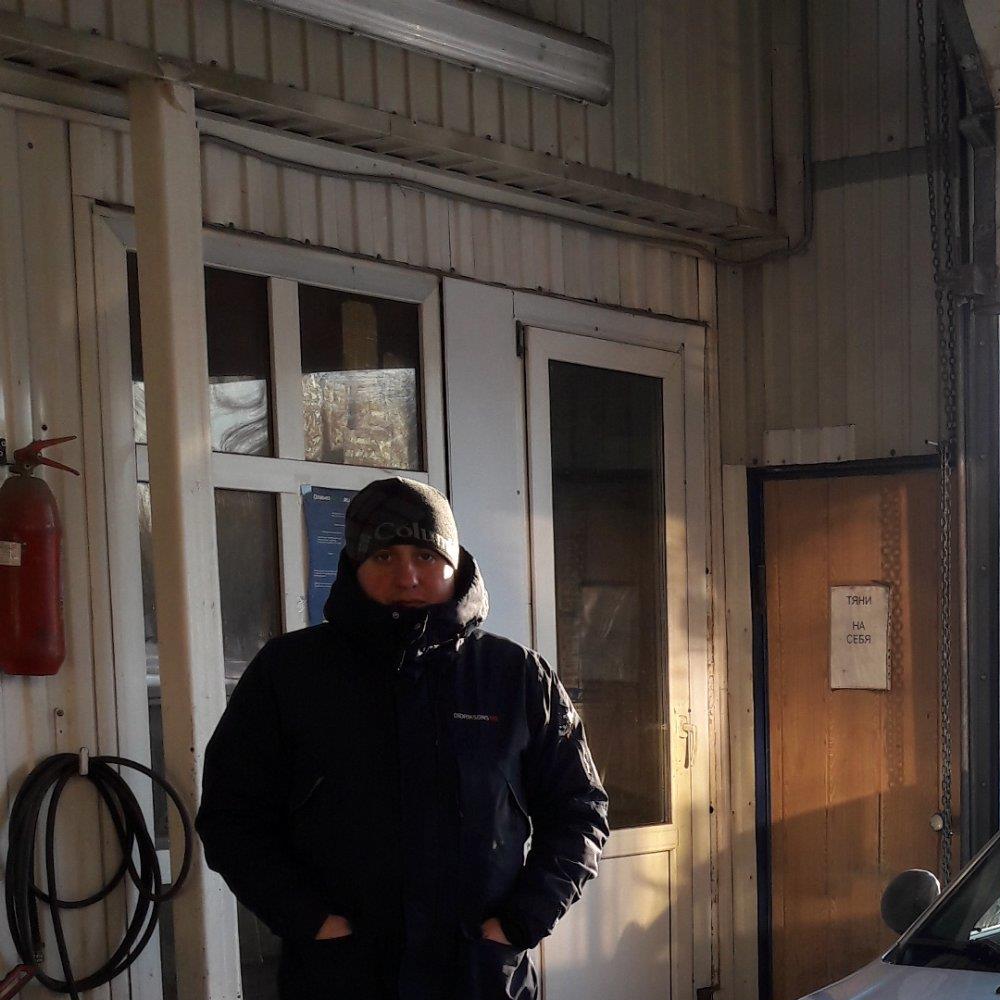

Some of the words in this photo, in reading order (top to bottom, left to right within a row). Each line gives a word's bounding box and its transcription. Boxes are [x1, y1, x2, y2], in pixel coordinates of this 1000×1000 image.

[846, 595, 872, 606] ТЯНИ
[852, 621, 866, 631] НА
[846, 633, 872, 645] СЕБЯ
